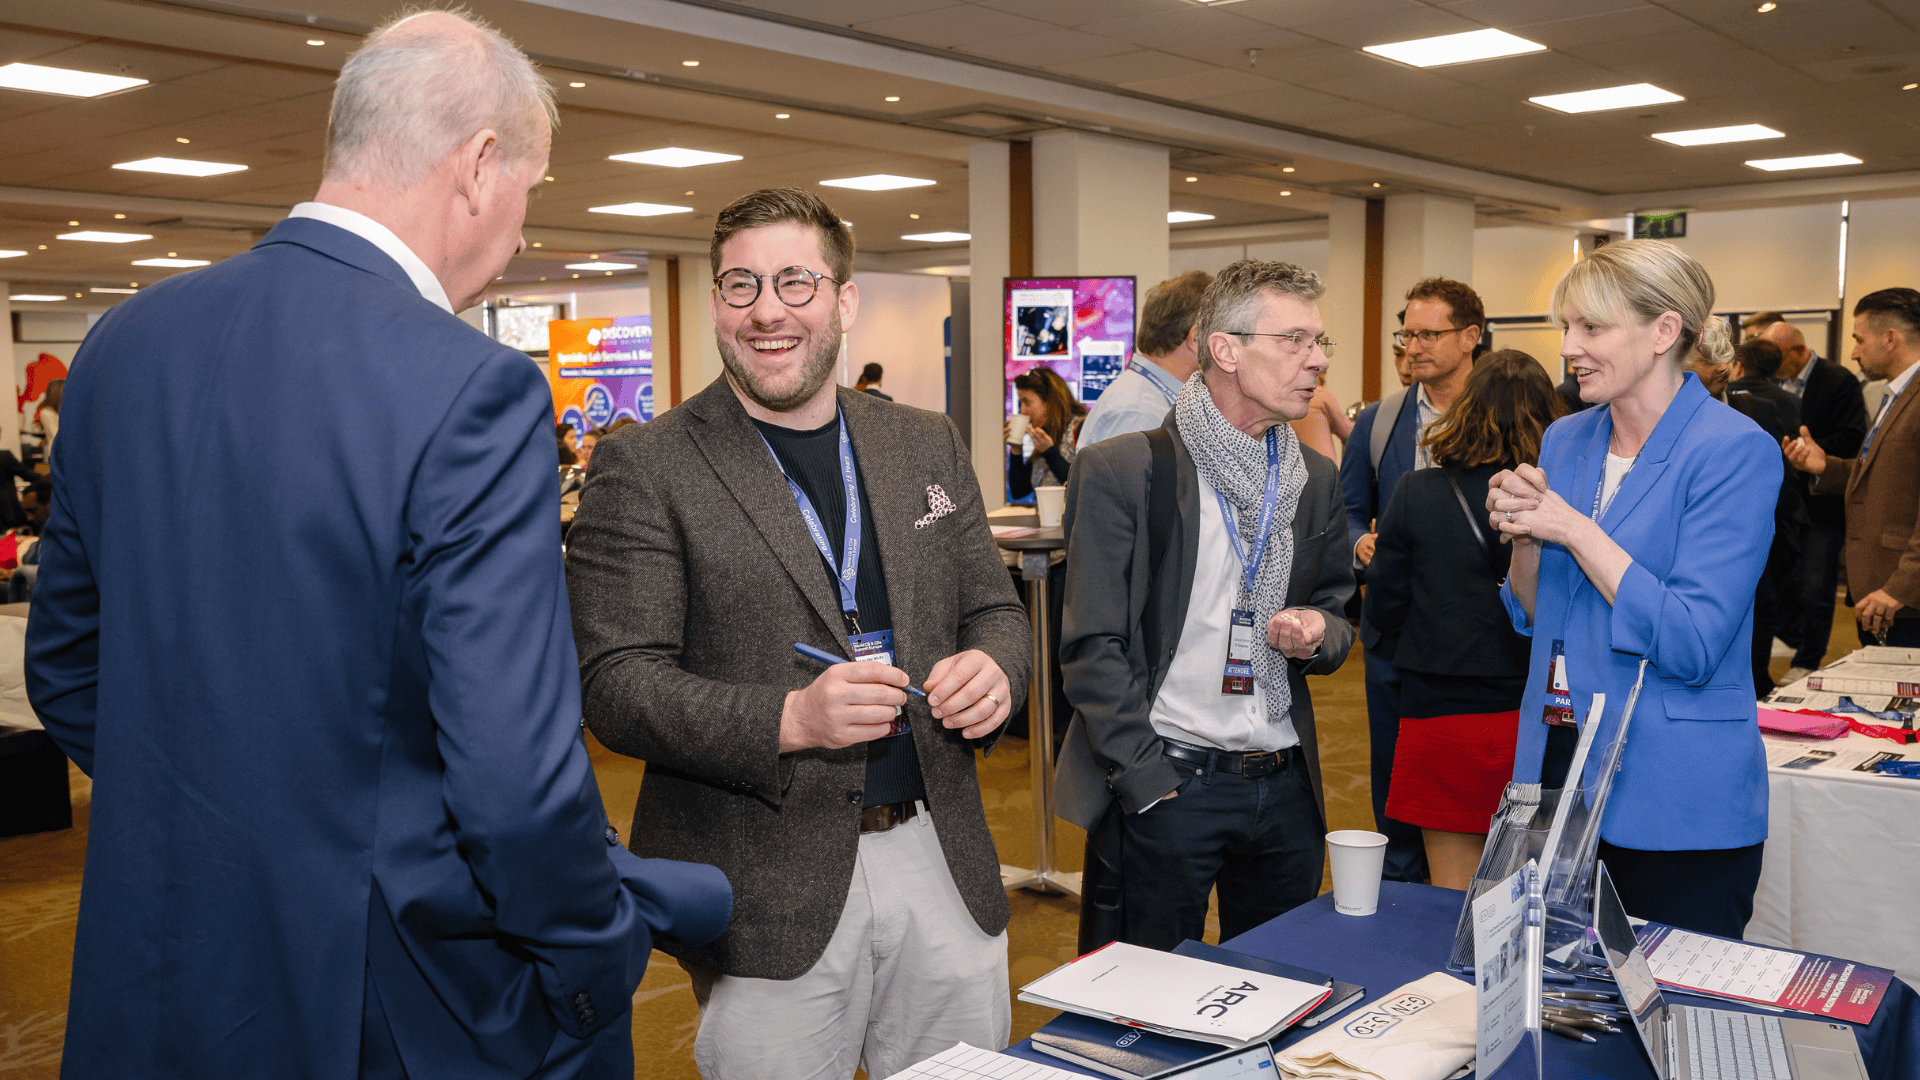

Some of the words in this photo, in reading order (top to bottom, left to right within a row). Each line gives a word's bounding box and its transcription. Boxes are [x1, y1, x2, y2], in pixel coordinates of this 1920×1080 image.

[601, 325, 652, 339] DISCOVERY
[557, 351, 587, 365] Specialty
[602, 350, 631, 363] Services
[846, 474, 853, 482] 15
[849, 484, 857, 524] Celebrating
[1258, 502, 1273, 540] Celebrating
[802, 508, 828, 552] Celebrating
[1256, 541, 1262, 549] 15
[1251, 550, 1261, 568] Years
[1227, 666, 1250, 675] ATTENDEE
[1196, 980, 1259, 1019] ARC
